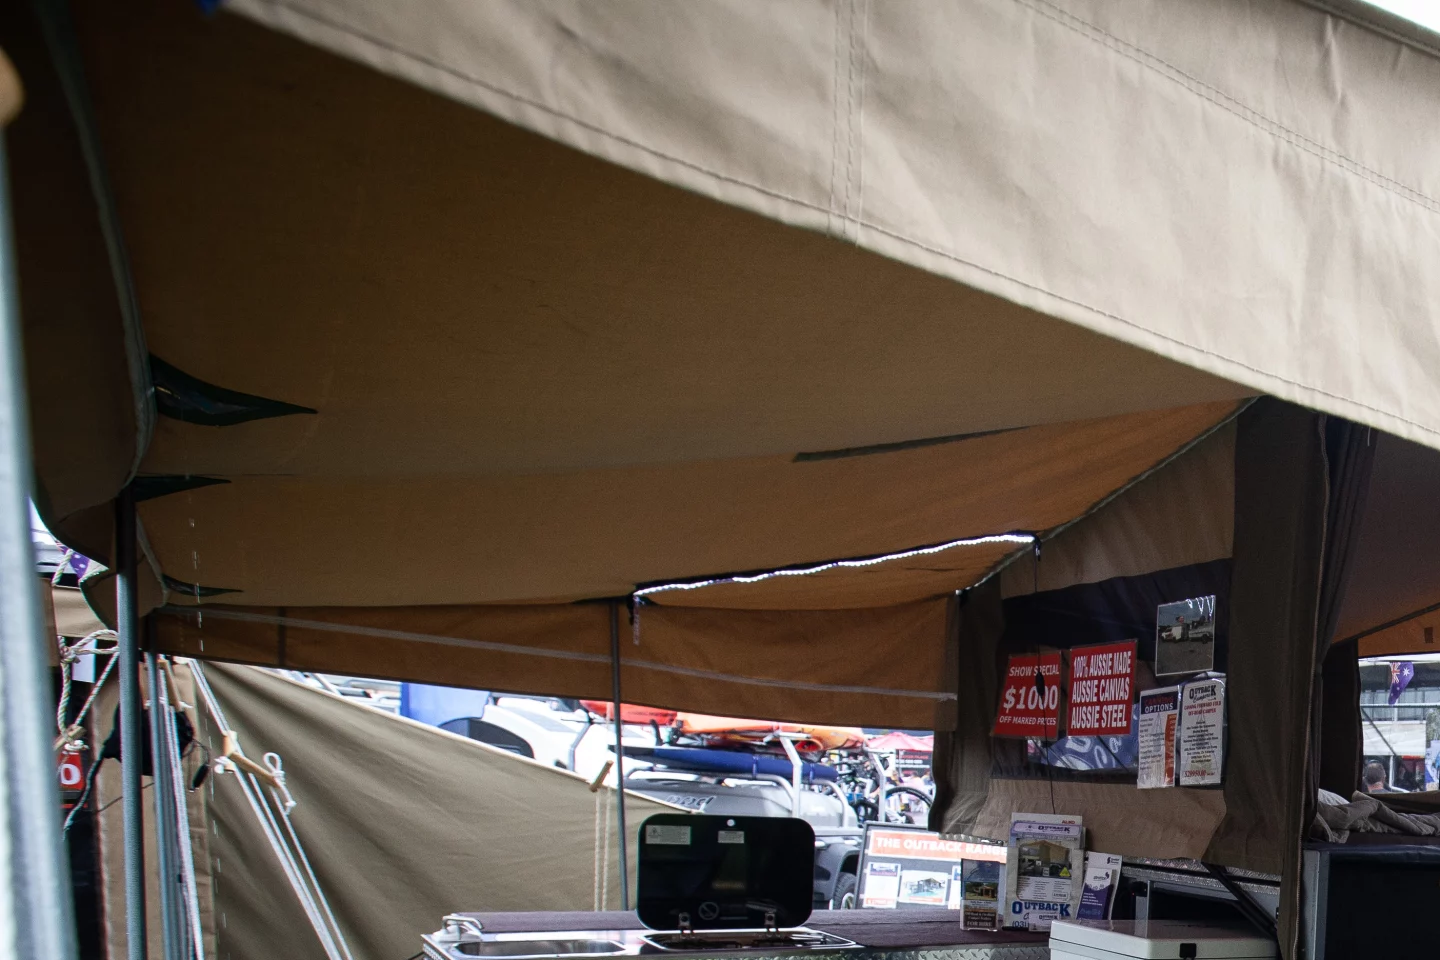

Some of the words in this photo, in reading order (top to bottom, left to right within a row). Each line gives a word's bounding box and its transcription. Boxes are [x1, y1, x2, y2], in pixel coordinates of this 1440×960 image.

[1009, 666, 1035, 676] SHOW
[1074, 655, 1088, 678] 100%
[1089, 653, 1112, 677] AUSSIE
[1113, 651, 1132, 674] MADE
[1071, 679, 1098, 703] AUSSIE
[1099, 677, 1130, 702] CANVAS
[1071, 706, 1100, 729] AUSSIE
[1101, 704, 1127, 728] STEEL
[1144, 702, 1174, 714] OPTIONS
[1000, 716, 1012, 724] OFF
[1012, 716, 1036, 725] MARKED
[875, 837, 900, 848] THE
[903, 838, 962, 852] OUTBACK
[965, 844, 1007, 855] RANGE
[1012, 901, 1071, 917] OUTBACK
